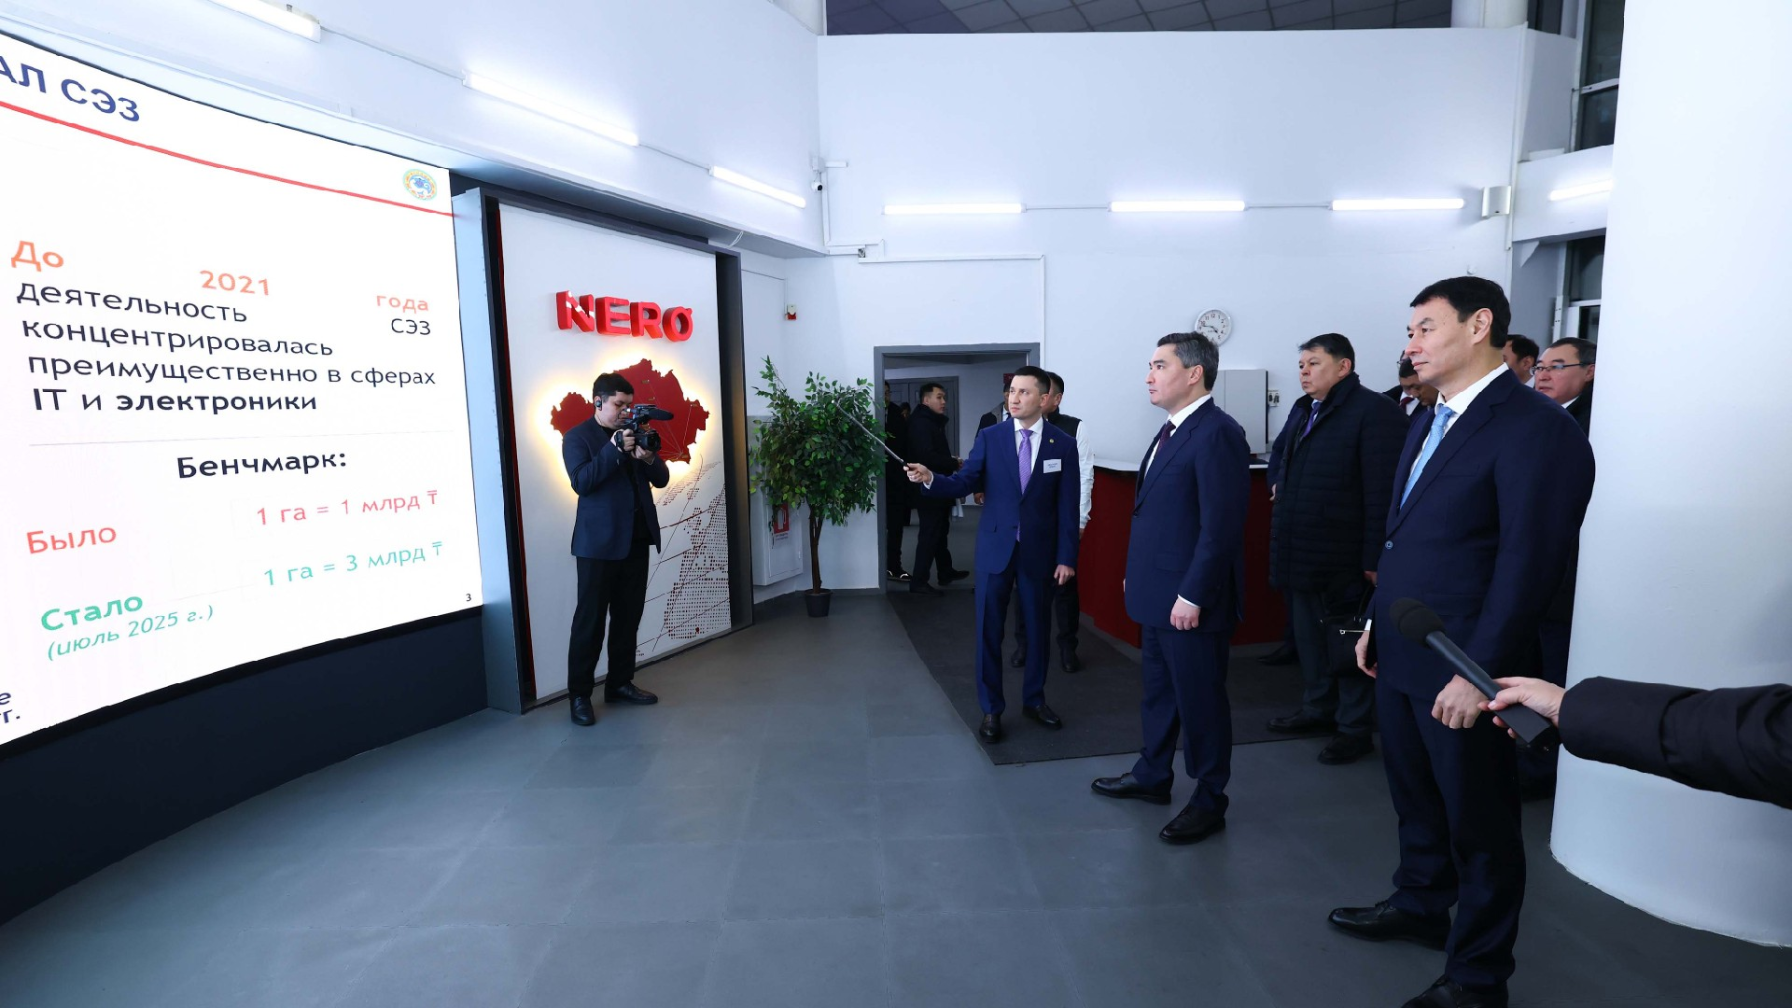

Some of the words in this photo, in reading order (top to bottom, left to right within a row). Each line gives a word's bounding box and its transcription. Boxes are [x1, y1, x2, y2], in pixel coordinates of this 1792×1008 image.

[60, 78, 140, 122] СЭЗ
[10, 240, 64, 272] До
[199, 269, 270, 296] 2021
[376, 295, 429, 314] года
[16, 282, 248, 323] деятельность
[390, 317, 431, 336] СЭЗ
[21, 320, 334, 356] концентрировалась
[28, 355, 318, 384] преимущественно
[327, 369, 342, 383] в
[350, 367, 436, 389] сферах
[32, 387, 68, 411] IT
[81, 393, 102, 411] и
[115, 394, 317, 416] электроники
[176, 451, 347, 479] Бенчмарк:
[257, 507, 266, 526] 1
[279, 507, 307, 523] га
[341, 499, 349, 515] 1
[362, 495, 421, 513] млрд
[26, 526, 118, 555] Было
[264, 568, 275, 586] 1
[287, 565, 314, 582] га
[346, 554, 358, 572] 3
[368, 548, 426, 568] млрд
[40, 595, 143, 631] Стало
[465, 593, 472, 603] 3
[47, 631, 120, 661] (июль
[128, 611, 178, 637] 2025
